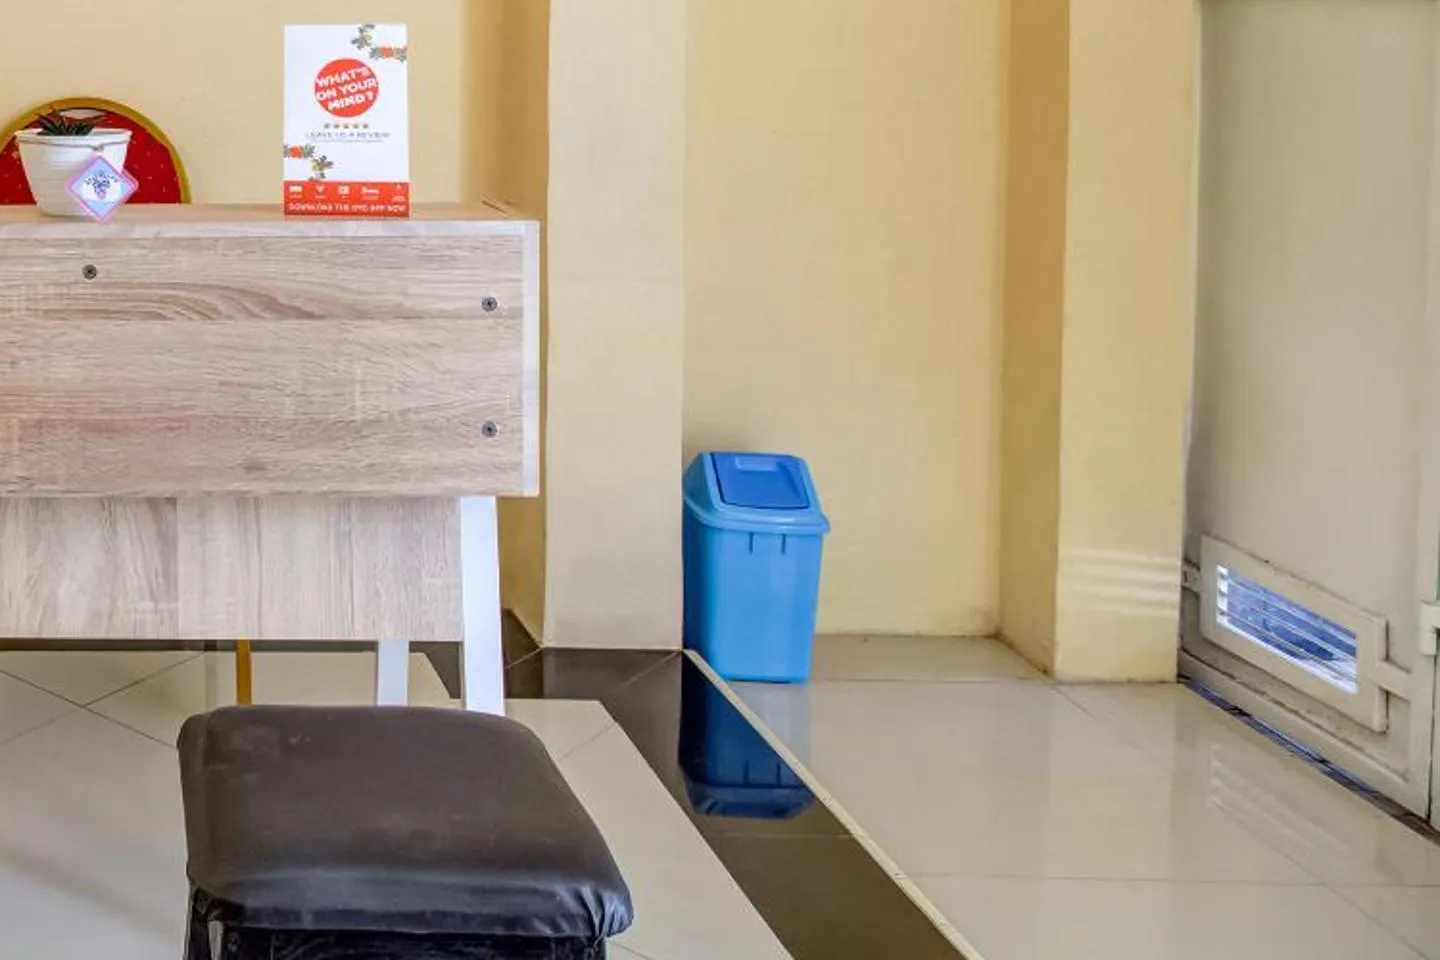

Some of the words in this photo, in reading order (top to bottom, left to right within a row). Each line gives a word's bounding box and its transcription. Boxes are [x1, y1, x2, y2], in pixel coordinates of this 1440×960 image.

[316, 66, 370, 87] WHAT'S
[316, 88, 337, 101] ON
[338, 78, 377, 95] YOUR
[327, 91, 374, 111] MIND?
